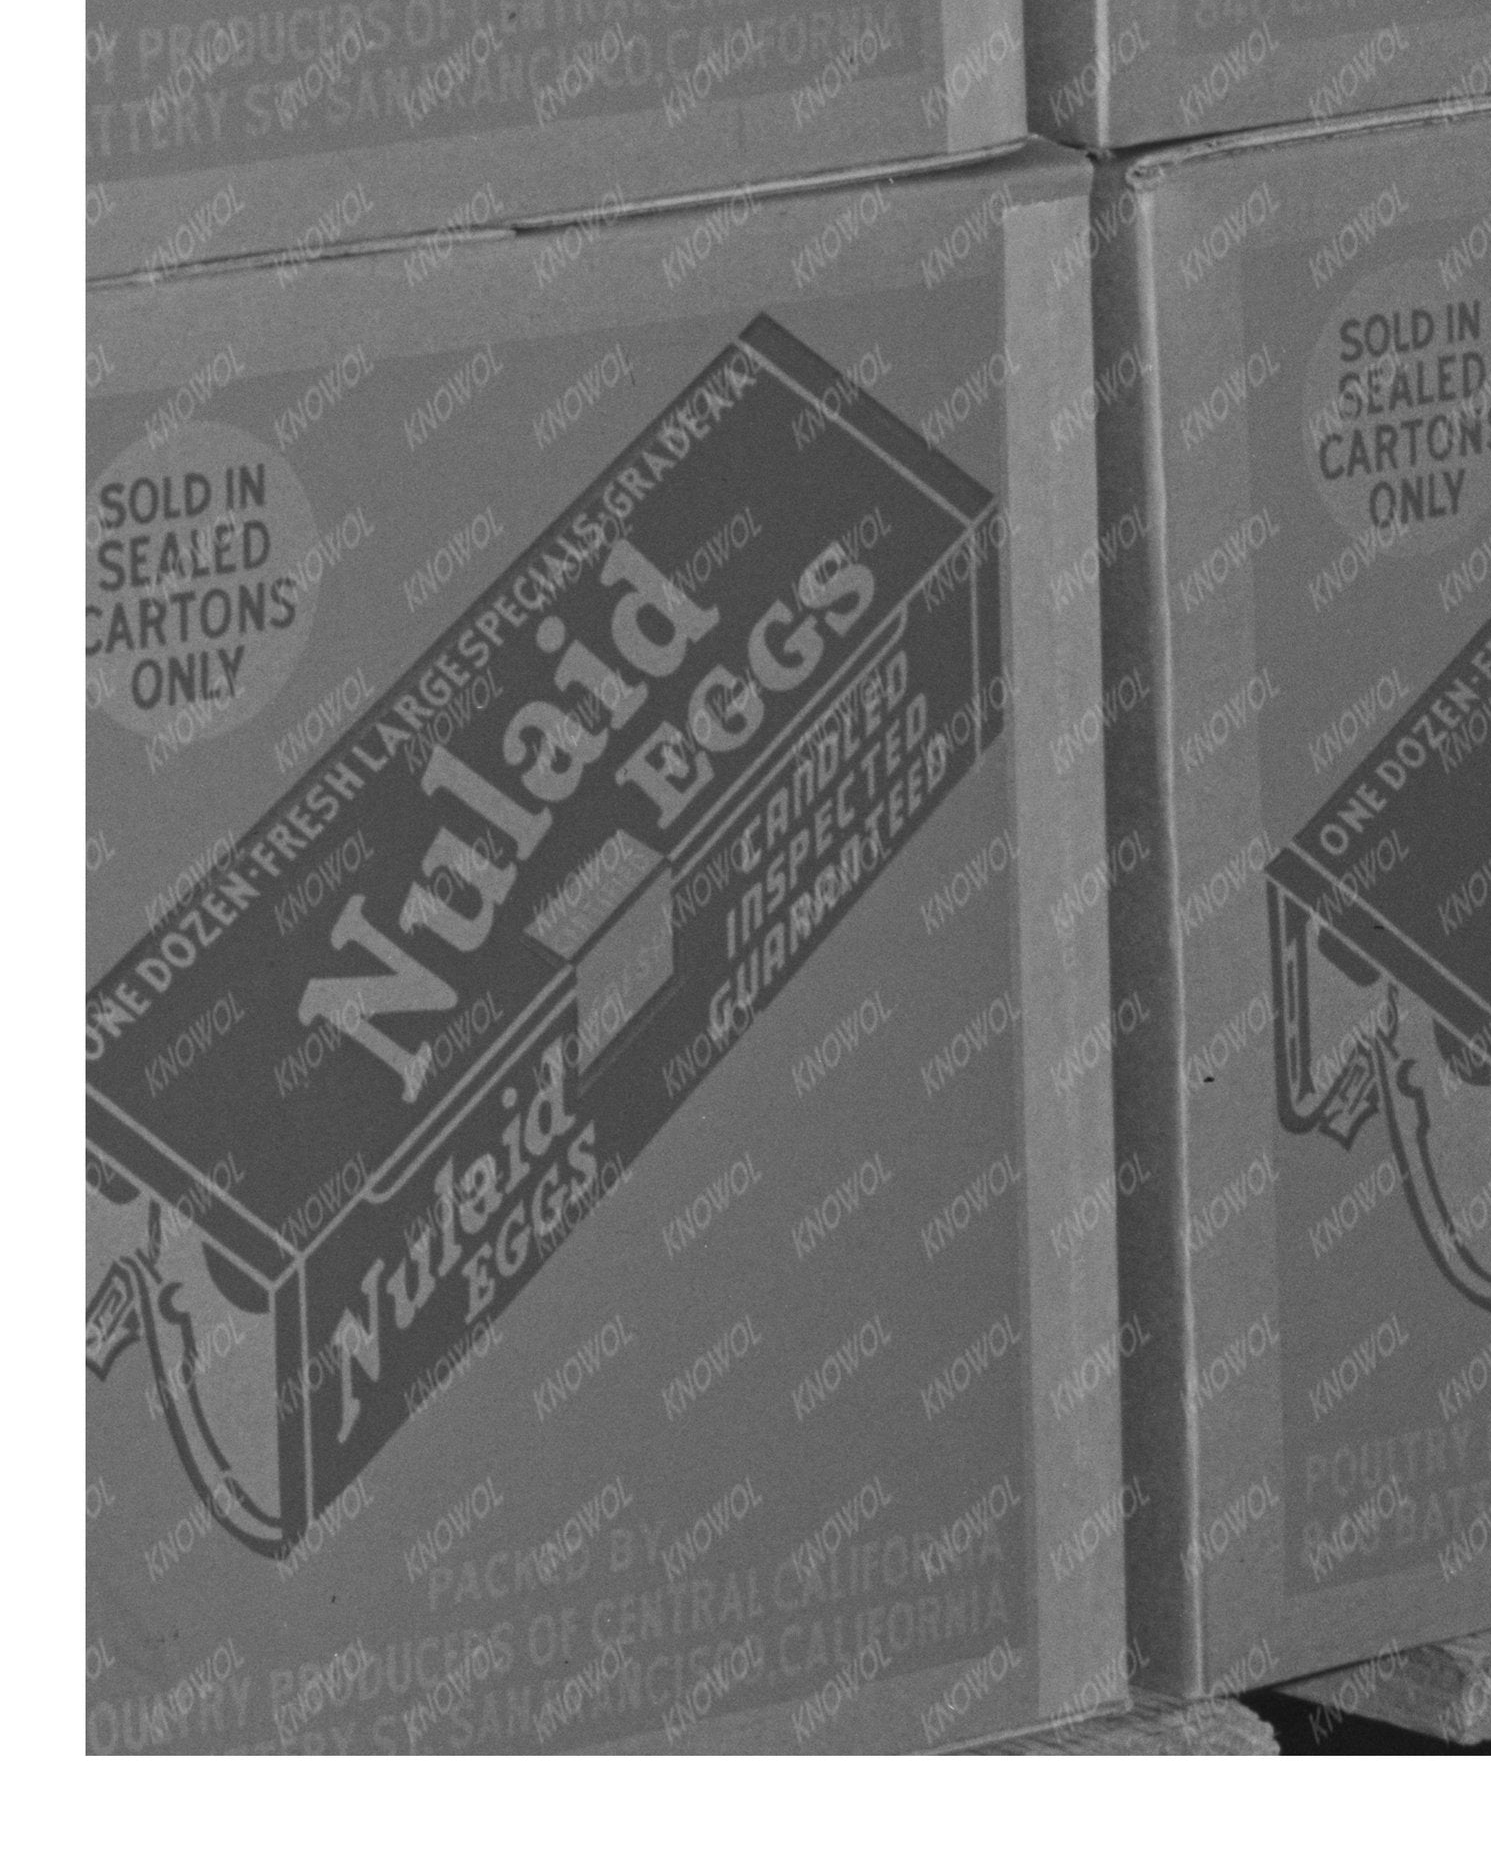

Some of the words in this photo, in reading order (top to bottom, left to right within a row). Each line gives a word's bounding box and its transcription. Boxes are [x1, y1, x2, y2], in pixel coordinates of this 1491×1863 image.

[1337, 307, 1436, 364] SOLD
[1446, 300, 1482, 346] IN
[1337, 352, 1488, 422] SEALED
[97, 468, 210, 534] SOLD
[224, 462, 266, 512] IN
[1367, 468, 1467, 531] ONLY
[95, 519, 271, 591] SEALED
[129, 644, 245, 712] ONLY
[139, 875, 262, 999] DOZEN
[253, 767, 363, 878] FRESH
[351, 656, 474, 791] LARGE
[455, 519, 604, 686] SPECIALS
[603, 408, 709, 521] GRADE
[703, 368, 754, 421] AA
[614, 544, 877, 830] EGGS
[296, 538, 720, 1105] Nulaid
[330, 1039, 574, 1442] Nulaid
[464, 1125, 599, 1326] EGGS
